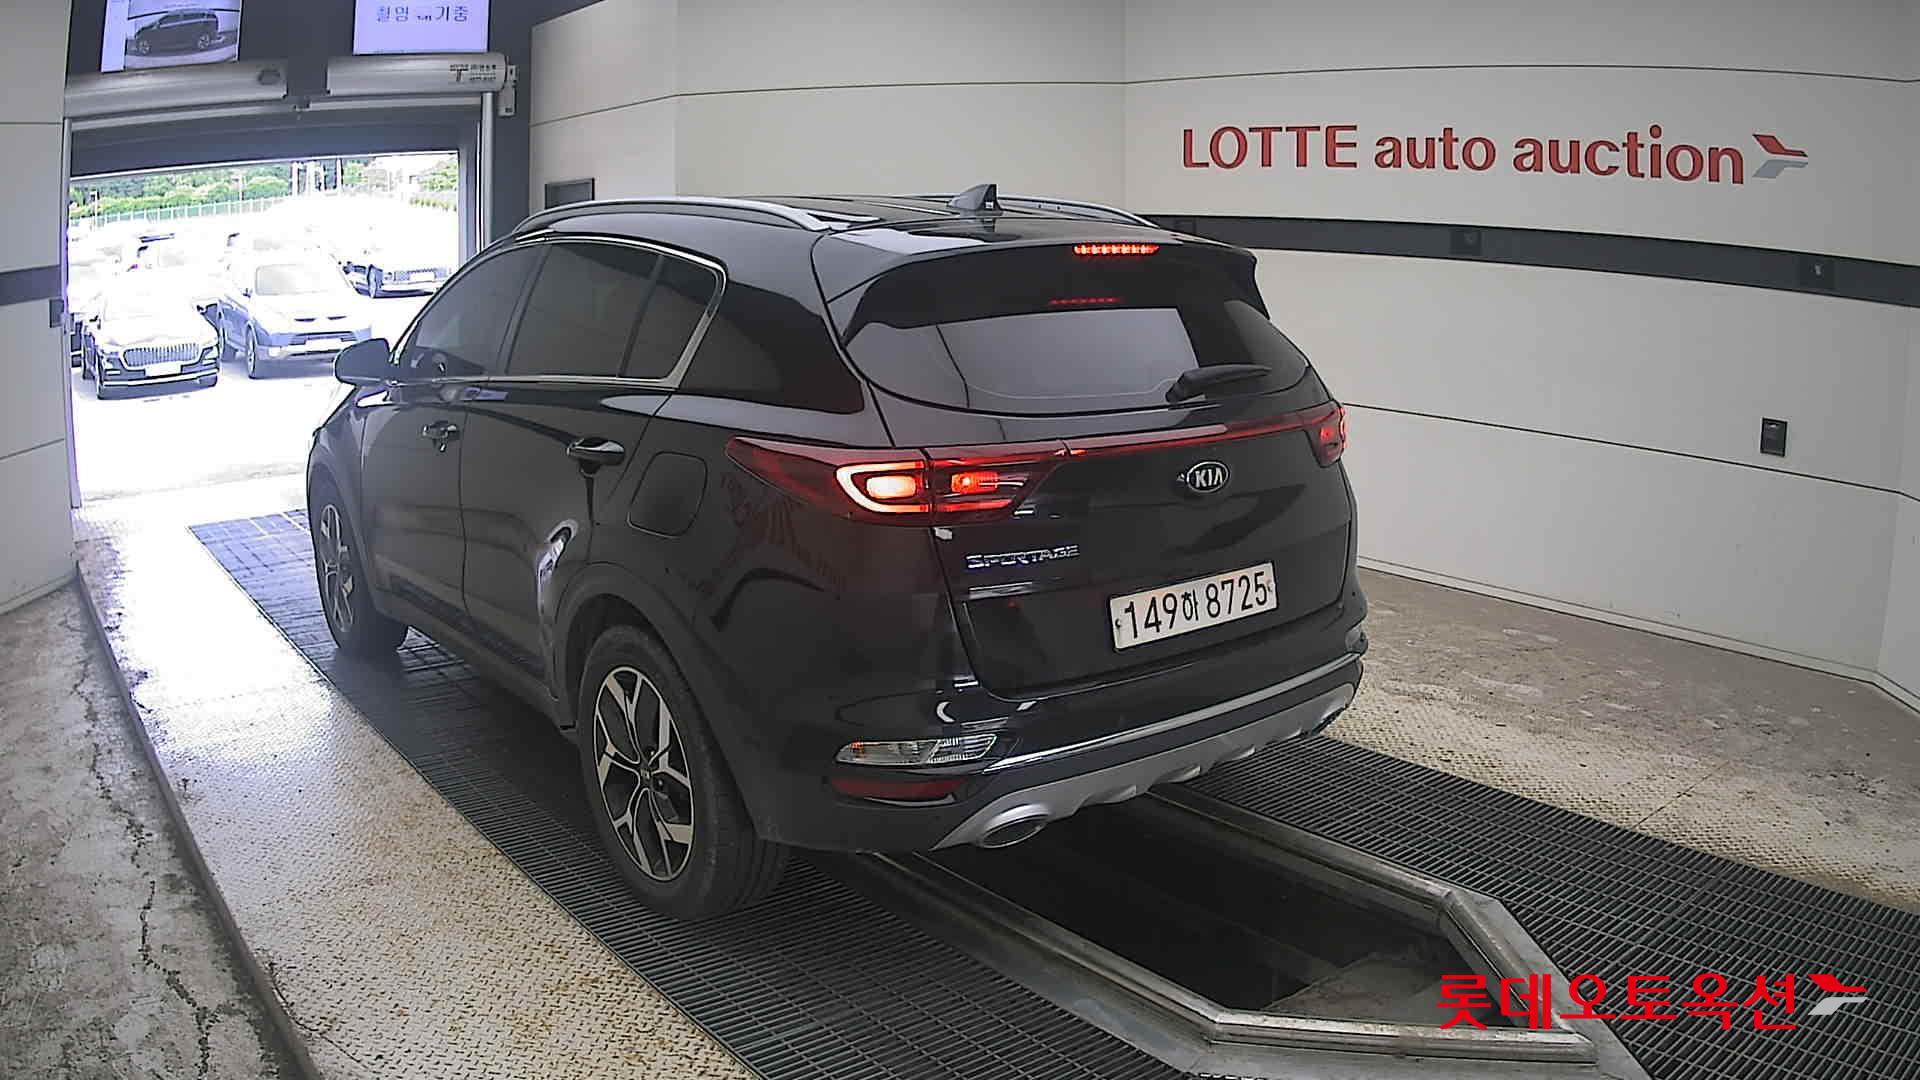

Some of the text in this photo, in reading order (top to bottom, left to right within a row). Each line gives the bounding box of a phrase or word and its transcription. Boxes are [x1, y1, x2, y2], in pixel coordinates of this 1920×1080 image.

[1183, 124, 1745, 185] LOTTE auto auction
[1124, 571, 1269, 640] 149하 8725
